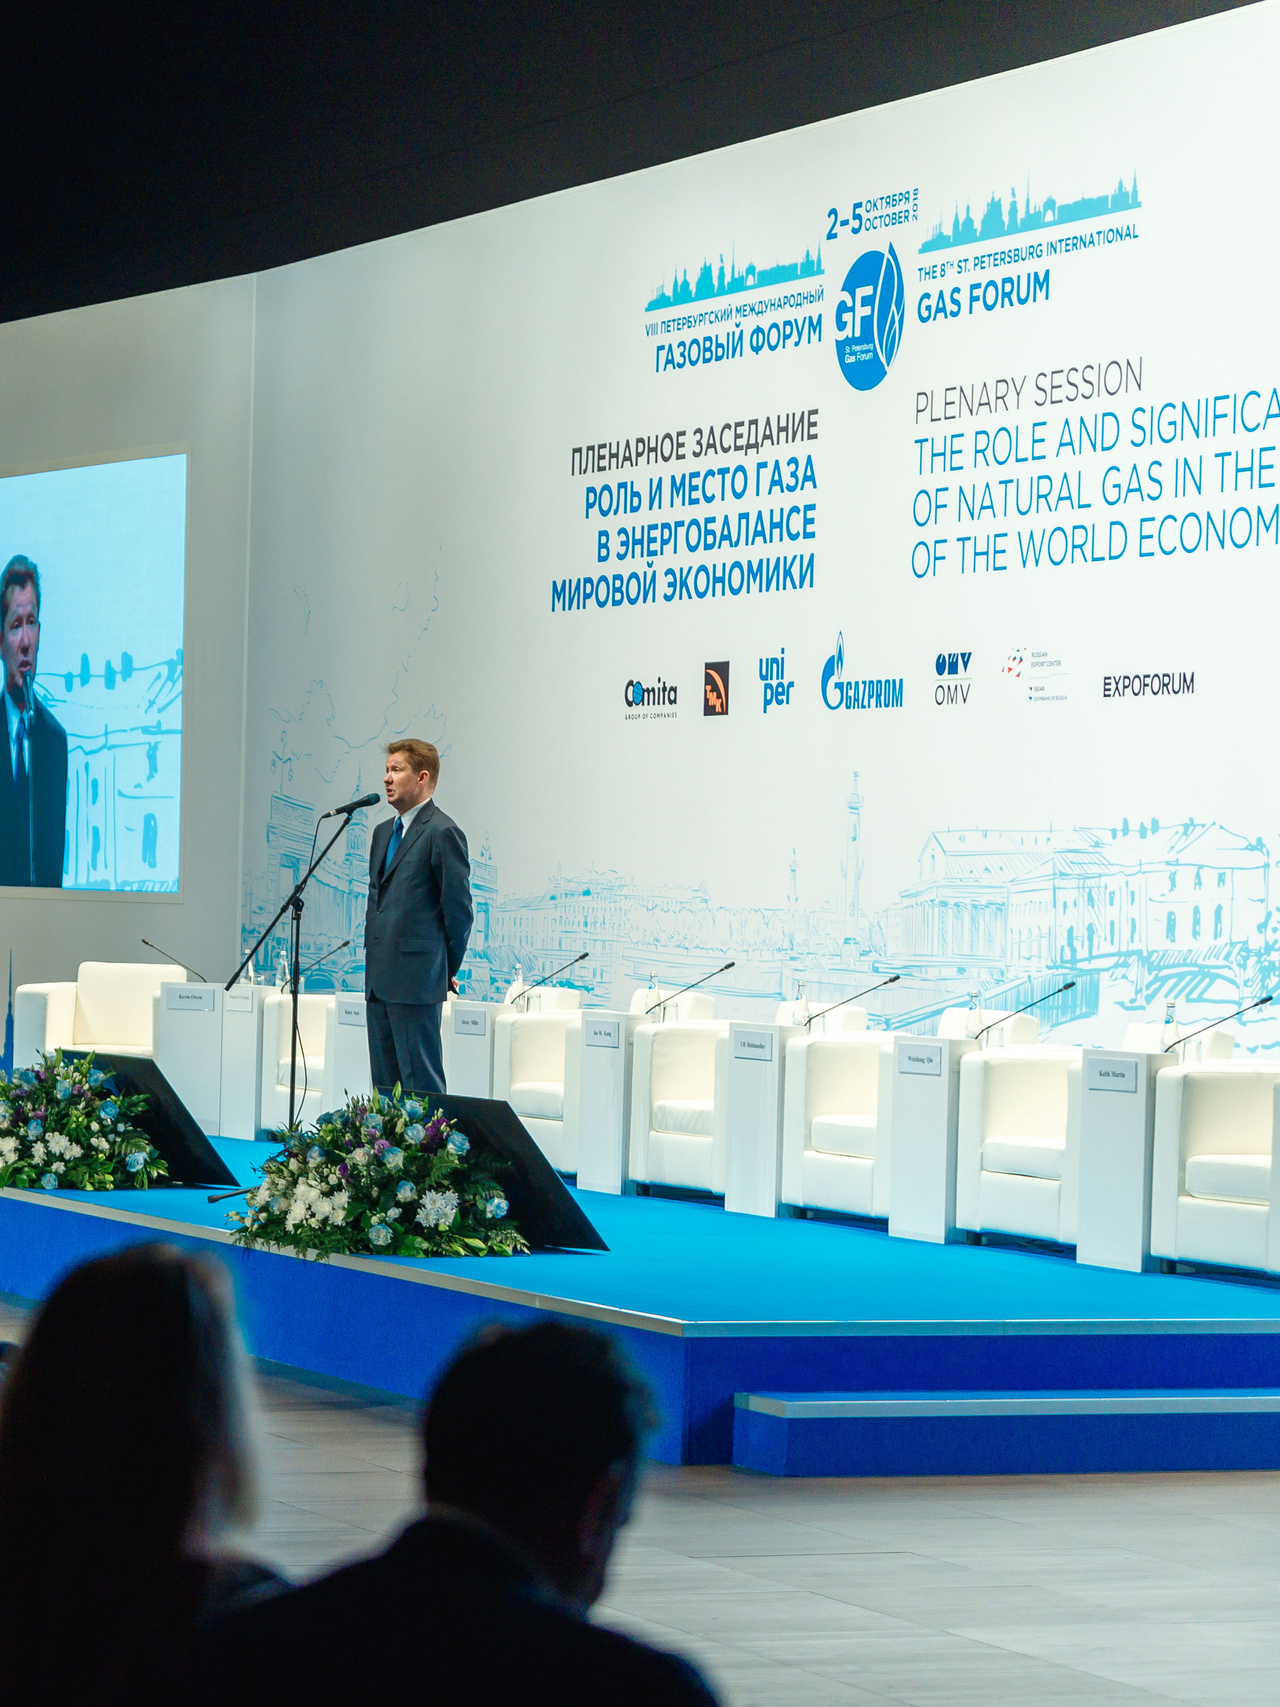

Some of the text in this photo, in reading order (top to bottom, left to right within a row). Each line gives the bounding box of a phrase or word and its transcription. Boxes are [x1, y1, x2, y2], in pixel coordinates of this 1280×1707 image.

[864, 209, 909, 231] OCTOBER
[865, 191, 910, 213] ОКТЯБРЯ
[917, 265, 938, 282] THE
[957, 258, 970, 275] ST.
[973, 243, 1043, 271] PETERSBURG
[1046, 223, 1139, 256] INTERNATIONAL
[645, 284, 824, 337] VIII ПЕТЕРБУРГСКИЙ МЕЖДУНАРОДНЫЙ
[831, 285, 873, 341] GF
[917, 269, 1050, 323] GAS FORUM
[655, 313, 822, 373] ГАЗОВЫЙ ФОРУМ
[845, 352, 873, 363] Gas Forum
[915, 356, 1142, 425] PLENARY SESSION
[571, 408, 819, 476] ПЛЕНАРНОЕ ЗАСЕДАНИЕ
[914, 433, 965, 475] THE
[974, 421, 1047, 468] ROLE
[1056, 412, 1120, 458] AND
[585, 454, 818, 519] РОЛЬ И МЕСТО ГАЗА
[913, 446, 1276, 527] OF NATURAL GAS IN THE
[597, 503, 817, 563] В ЭНЕРГОБАЛАНСЕ
[911, 503, 1280, 579] OF THE WORLD ECONOM
[551, 553, 815, 613] МИРОВОЙ ЭКОНОМИКИ
[624, 676, 678, 707] Comita
[758, 647, 785, 681] uni
[1103, 671, 1194, 697] EXPOFORUM
[763, 681, 794, 713] per
[845, 678, 903, 710] GAZPROM
[935, 683, 971, 705] OMV
